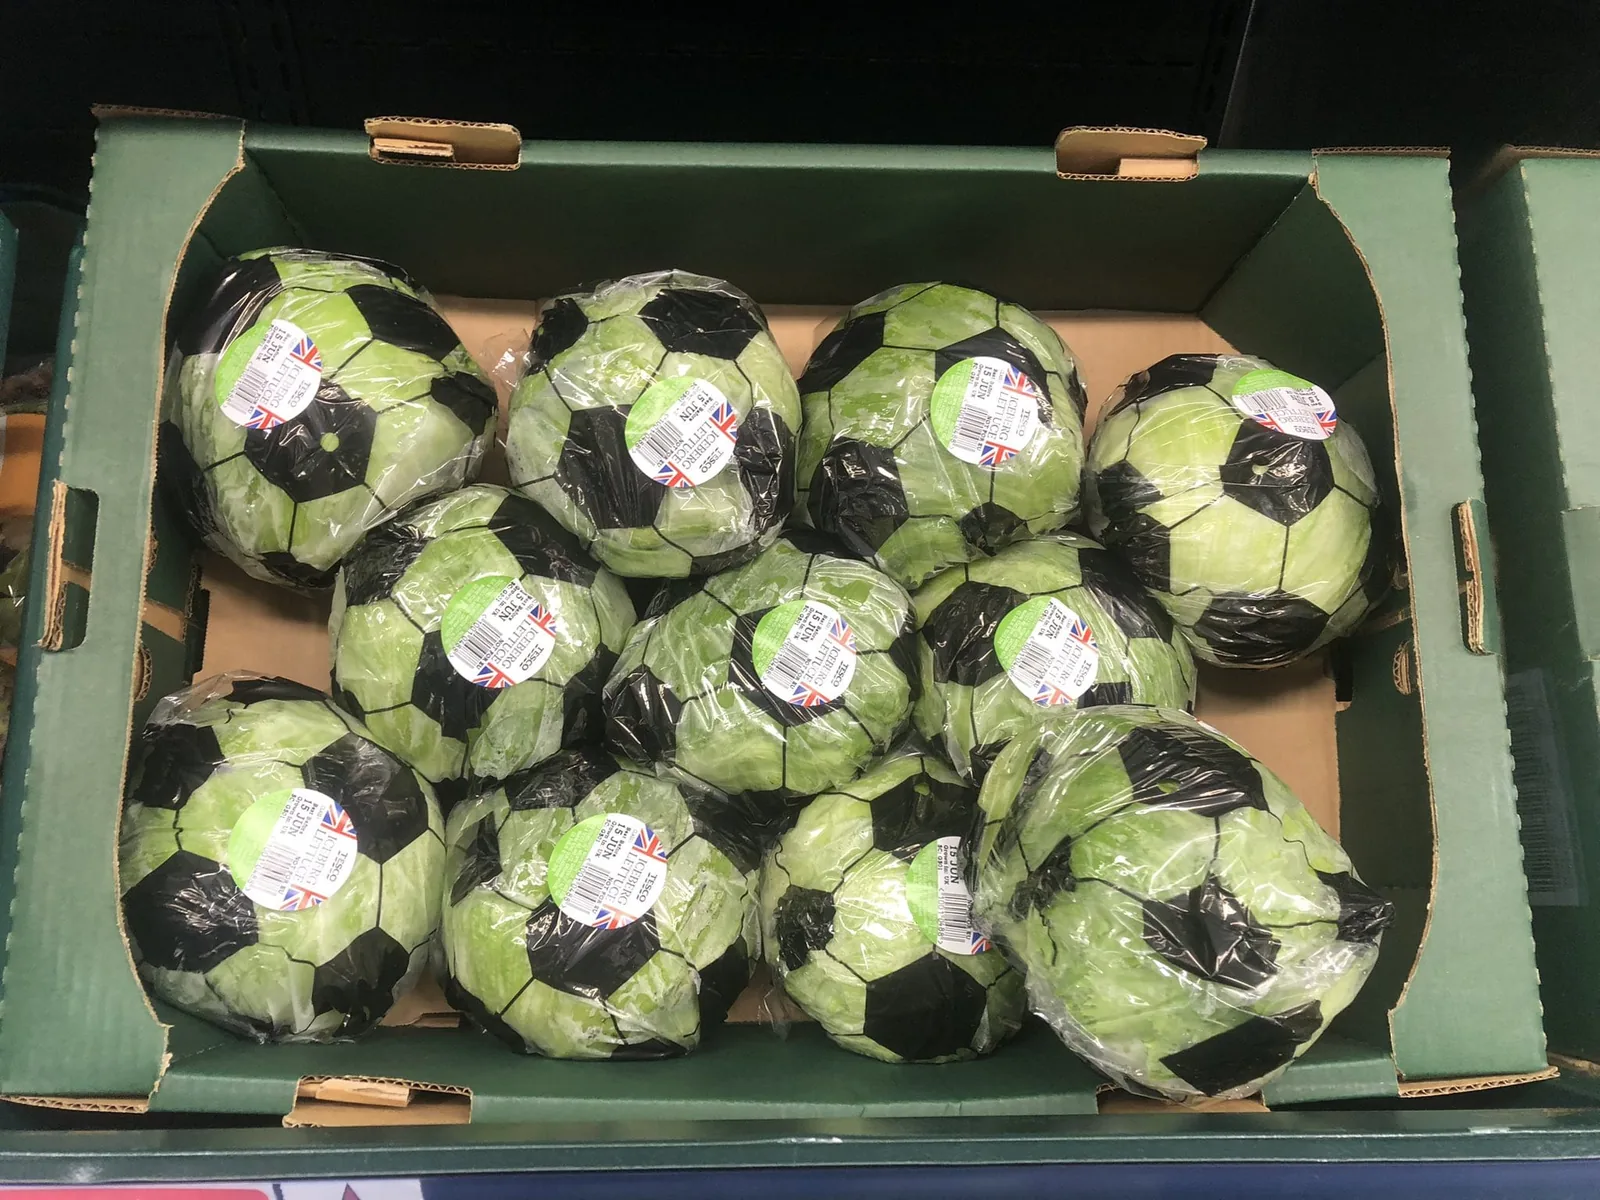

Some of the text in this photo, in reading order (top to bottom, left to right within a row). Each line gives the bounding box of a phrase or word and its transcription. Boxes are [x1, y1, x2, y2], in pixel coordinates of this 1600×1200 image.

[274, 327, 286, 340] 15
[261, 341, 278, 364] JUN
[259, 357, 293, 406] LETTUCE
[270, 363, 302, 410] ICEBERG
[289, 379, 310, 409] TESCO
[696, 389, 708, 402] 15
[976, 365, 992, 400] 15 JUN
[678, 401, 698, 422] JUN
[702, 396, 712, 407] Best
[987, 390, 1008, 440] LETTUCE
[998, 395, 1018, 441] ICEBERG
[1017, 408, 1030, 437] TESCO
[656, 438, 683, 468] NOT FOR EU
[670, 420, 711, 464] LETTUCE
[680, 429, 719, 471] ICEBERG
[700, 448, 724, 474] TESCO
[497, 588, 527, 622] 15 JUN
[521, 594, 532, 606] Best
[800, 610, 822, 642] 15 JUN
[818, 614, 827, 625] Best
[1044, 608, 1064, 640] 15 JUN
[476, 638, 503, 670] NOT FOR EU
[490, 618, 530, 665] LETTUCE
[501, 627, 538, 670] ICEBERG
[520, 644, 544, 672] TESCO
[790, 657, 810, 690] NOT FOR EU
[802, 638, 831, 683] LETTUCE
[813, 645, 840, 688] ICEBERG
[832, 661, 849, 688] TESCO
[1046, 636, 1074, 682] LETTUCE
[1056, 643, 1082, 687] ICEBERG
[1075, 659, 1091, 688] TESCO
[287, 797, 312, 837] 15 JUN
[621, 826, 631, 839] Best
[292, 828, 325, 883] LETTUCE
[601, 822, 625, 860] 15 JUN
[306, 834, 336, 885] ICEBERG
[328, 850, 347, 882] TESCO
[950, 862, 959, 884] JUN
[604, 851, 637, 903] LETTUCE
[617, 858, 647, 906] ICEBERG
[638, 872, 657, 903] TESCO
[590, 876, 613, 914] NOT FOR EU
